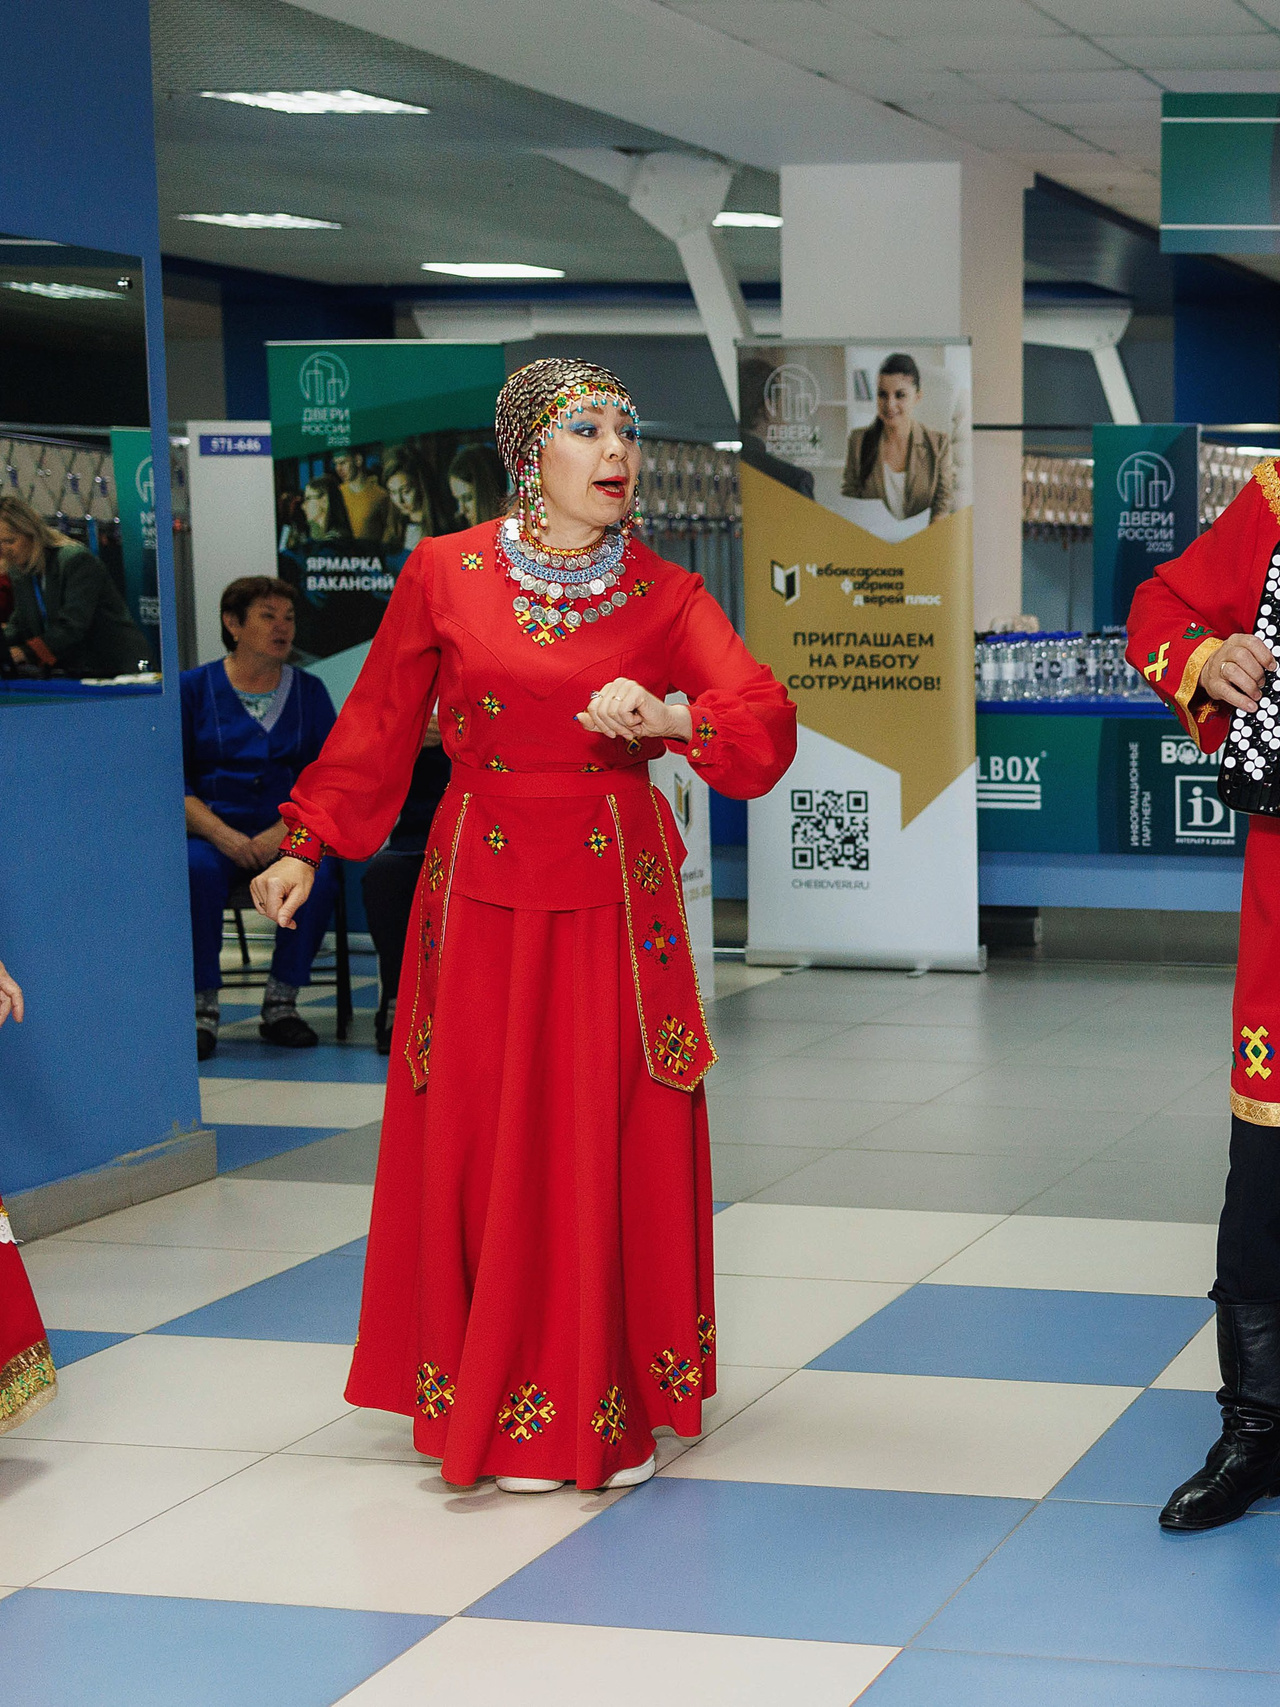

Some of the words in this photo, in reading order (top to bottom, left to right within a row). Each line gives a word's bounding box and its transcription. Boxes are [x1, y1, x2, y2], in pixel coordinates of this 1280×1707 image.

[303, 408, 350, 422] ДВЕРИ
[302, 424, 350, 435] РОССИИ
[1119, 511, 1175, 527] ДВЕРИ
[1117, 527, 1175, 540] РОССИИ
[1145, 541, 1175, 552] 2025
[306, 556, 382, 572] ЯРМАРКА
[306, 573, 395, 591] ВАКАНСИЙ
[793, 631, 934, 647] ПРИГЛАШАЕМ
[809, 653, 837, 668] НА
[843, 653, 919, 669] РАБОТУ
[787, 674, 941, 692] СОТРУДНИКОВ!
[1129, 741, 1140, 847] ИНФОРМАЦИОННЫЕ
[1141, 791, 1152, 847] ПАРТНЕРЫ
